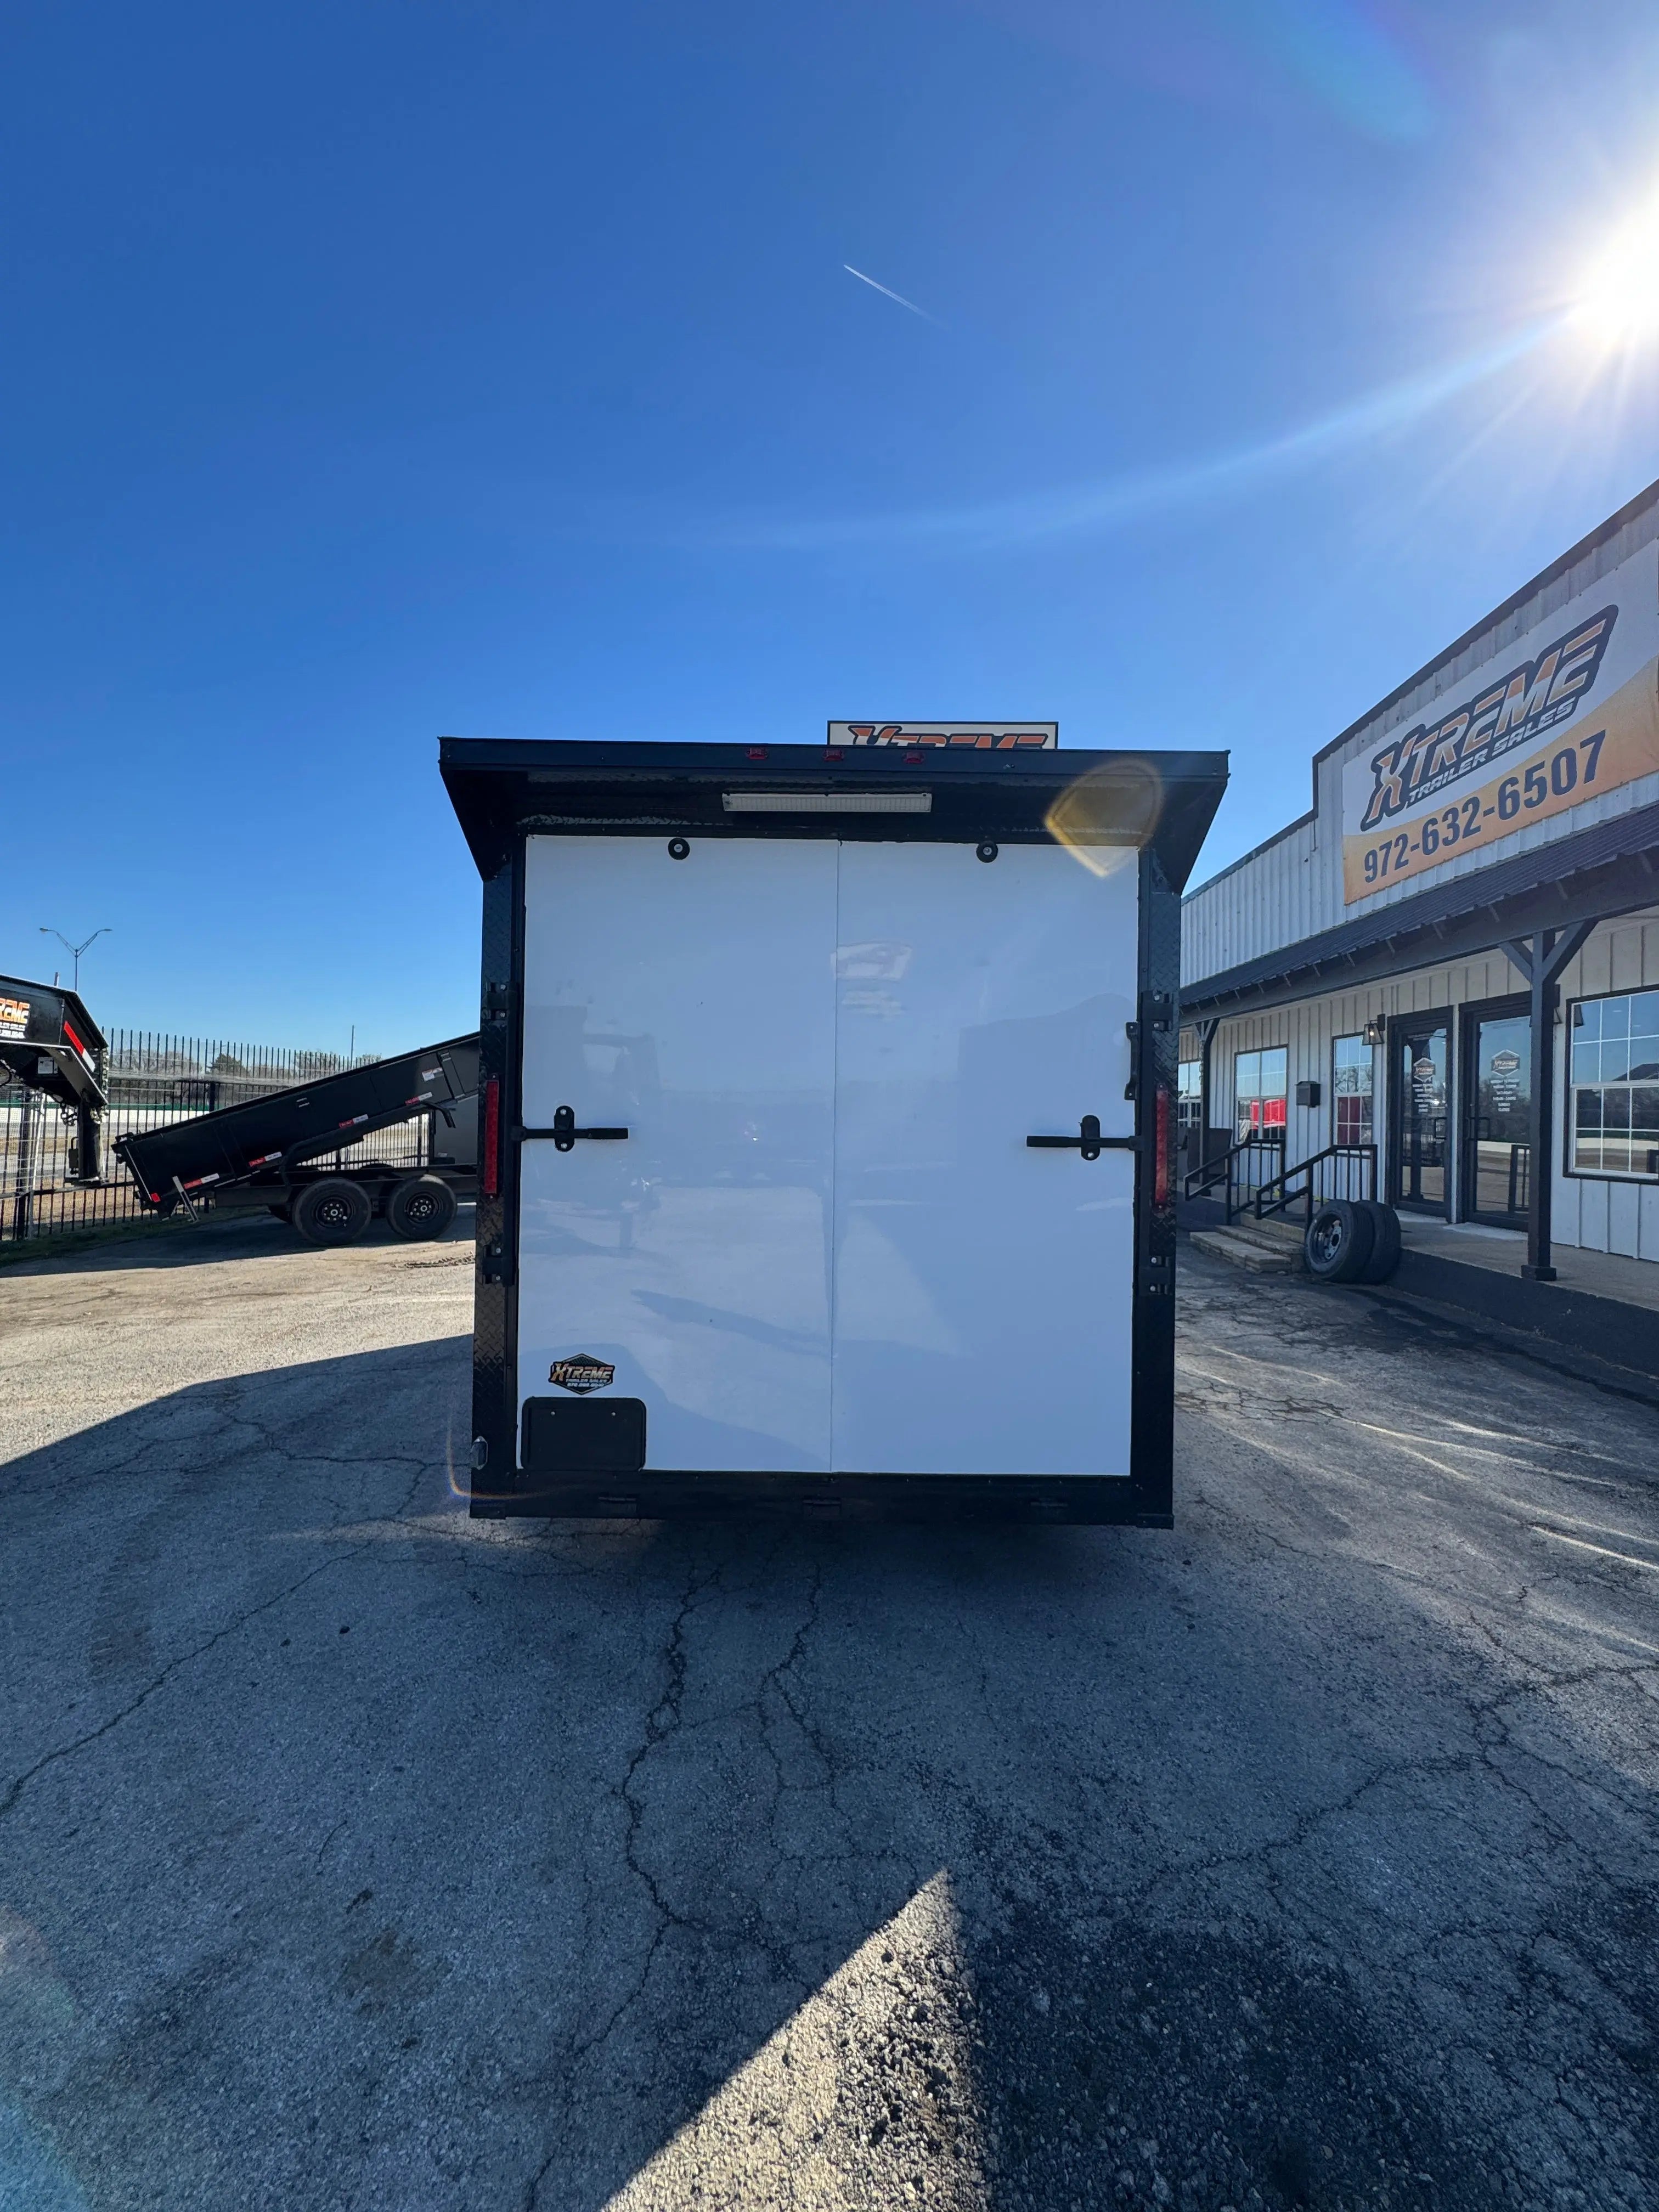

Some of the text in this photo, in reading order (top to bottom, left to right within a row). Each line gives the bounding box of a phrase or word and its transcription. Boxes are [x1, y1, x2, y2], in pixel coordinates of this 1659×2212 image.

[1365, 617, 1607, 824] XTREME
[1408, 696, 1578, 804] TRAILER SALES
[1364, 729, 1607, 884] 972-632-6507
[550, 1363, 613, 1381] XTREME
